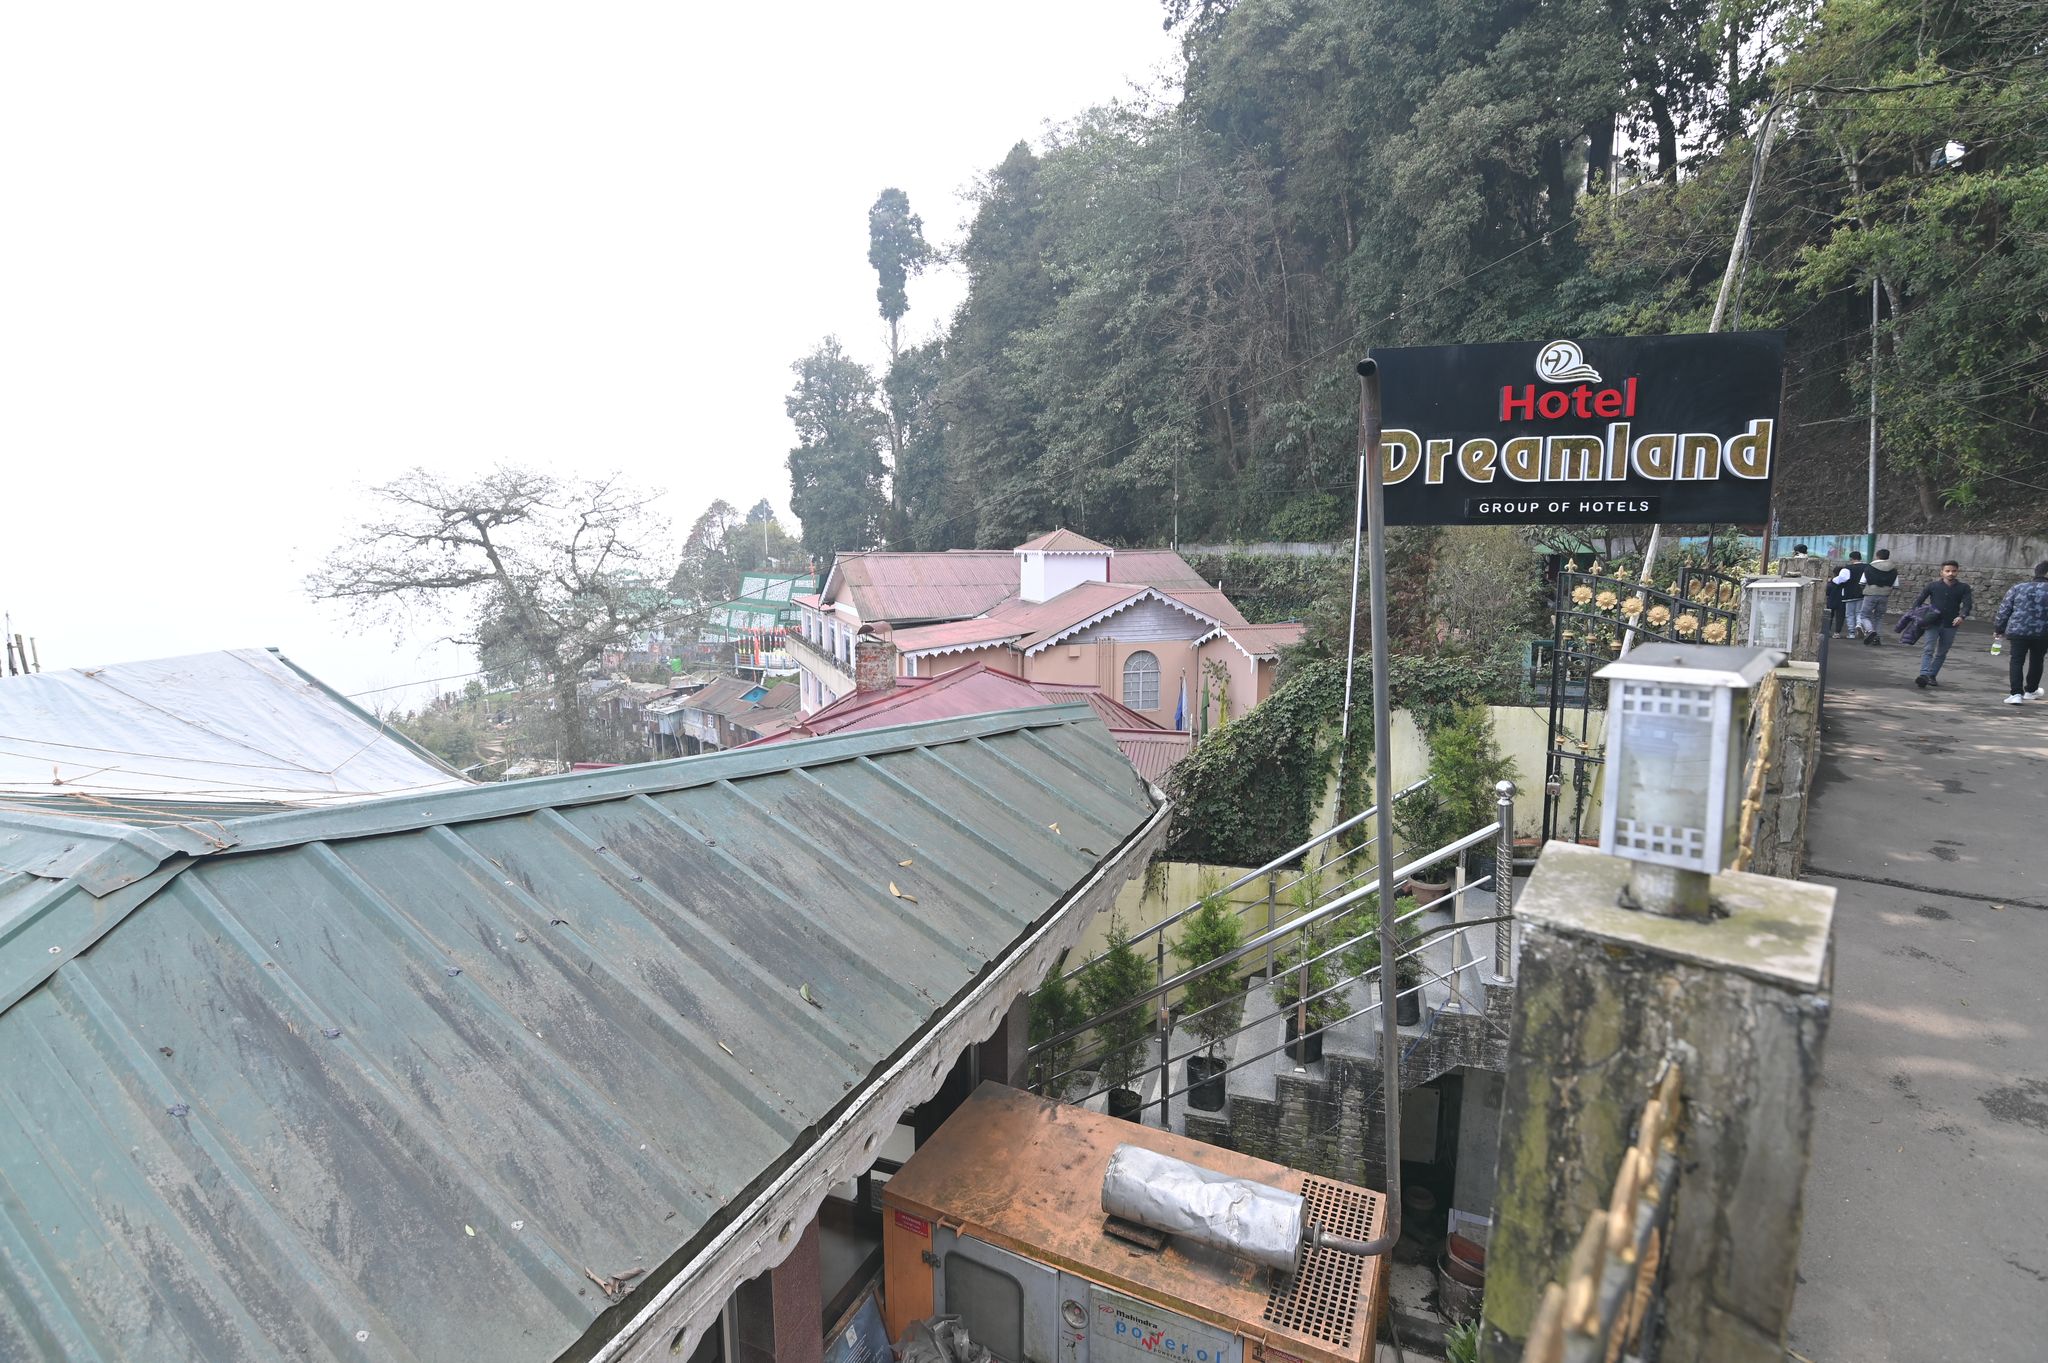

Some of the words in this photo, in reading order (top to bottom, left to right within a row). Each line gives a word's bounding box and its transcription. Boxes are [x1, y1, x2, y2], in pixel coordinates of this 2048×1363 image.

[1500, 377, 1638, 421] Hotel
[1380, 418, 1774, 487] Dreamland
[1478, 501, 1540, 514] GROUP
[1548, 501, 1571, 513] OF
[1579, 500, 1650, 513] HOTELS
